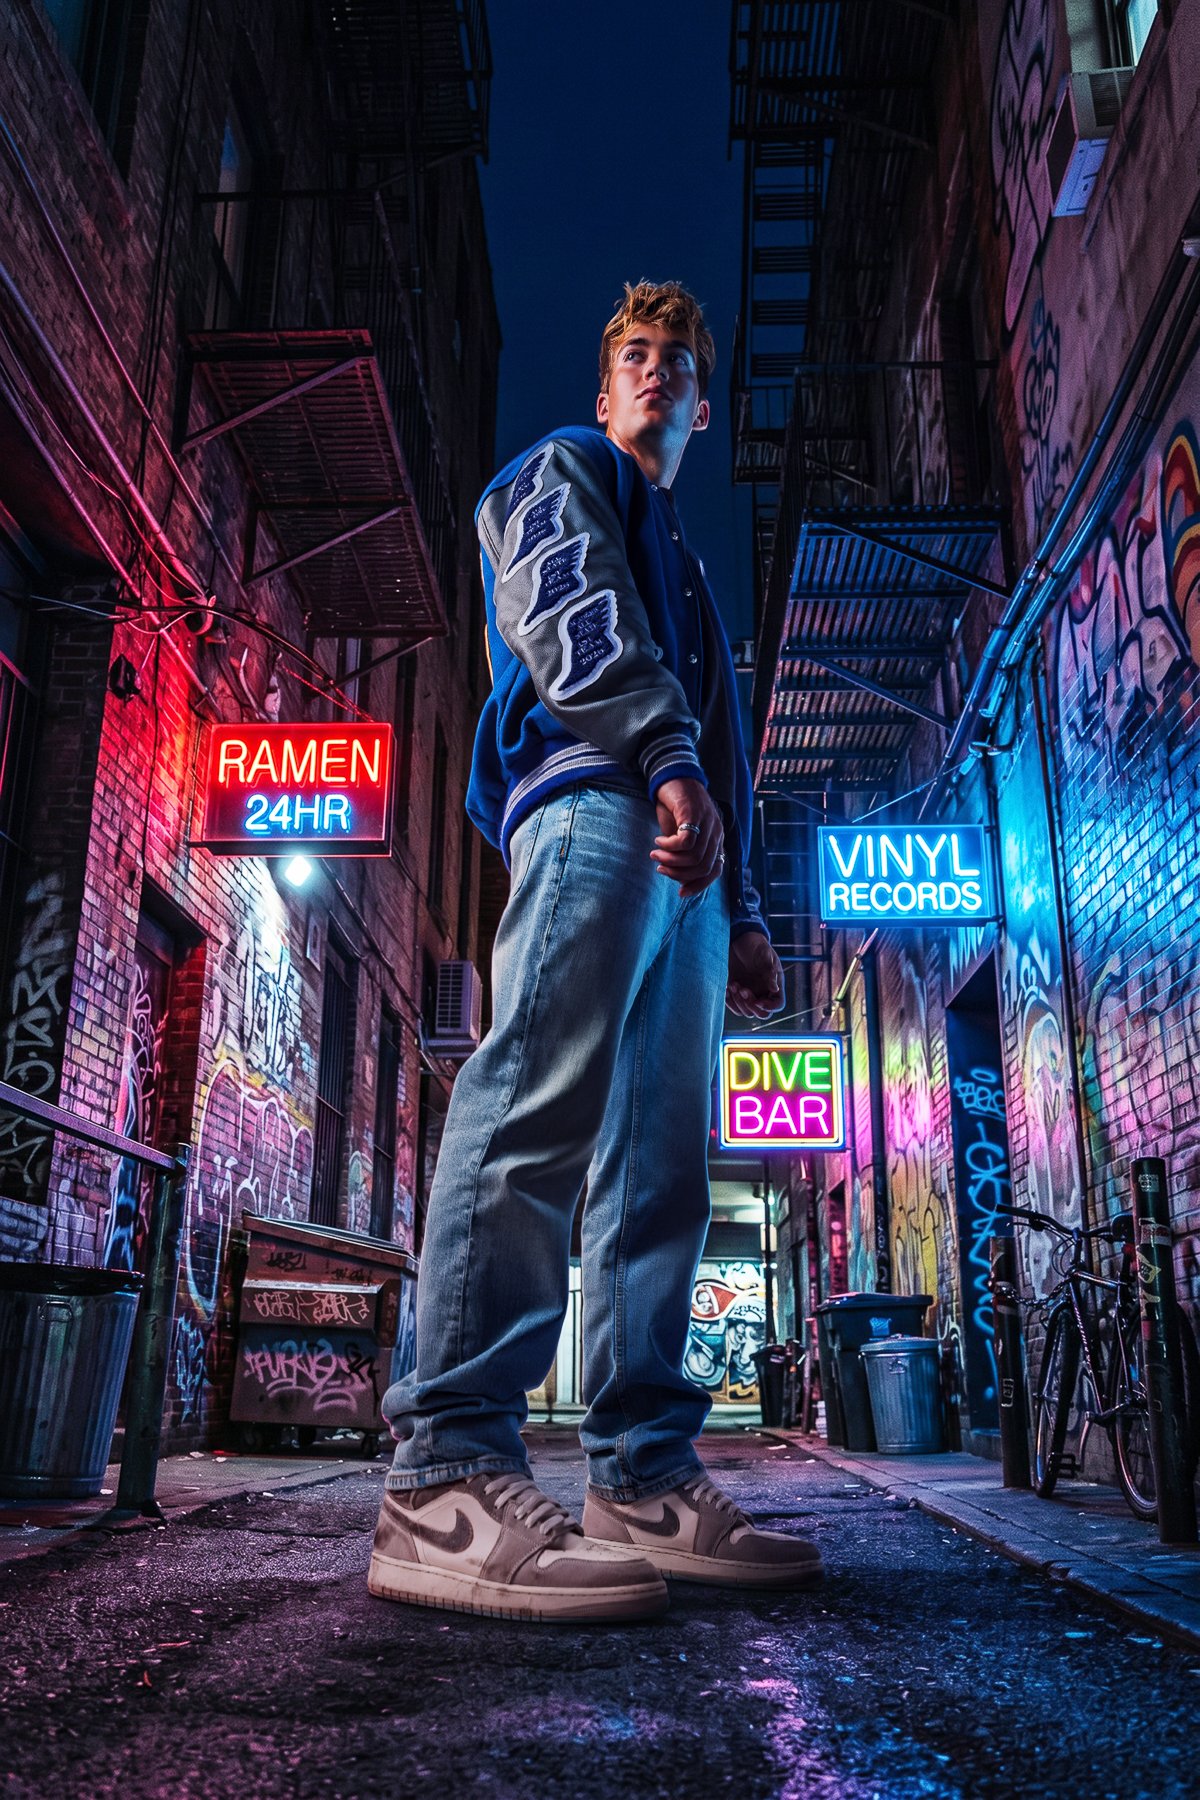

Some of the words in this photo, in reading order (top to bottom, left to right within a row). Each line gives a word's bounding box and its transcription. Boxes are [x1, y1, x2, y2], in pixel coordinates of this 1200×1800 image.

[218, 739, 380, 783] RAMEN
[245, 794, 349, 831] 24HR
[828, 833, 980, 878] VINYL
[829, 881, 982, 912] RECORDS
[729, 1051, 831, 1092] DIVE
[735, 1095, 829, 1135] BAR
